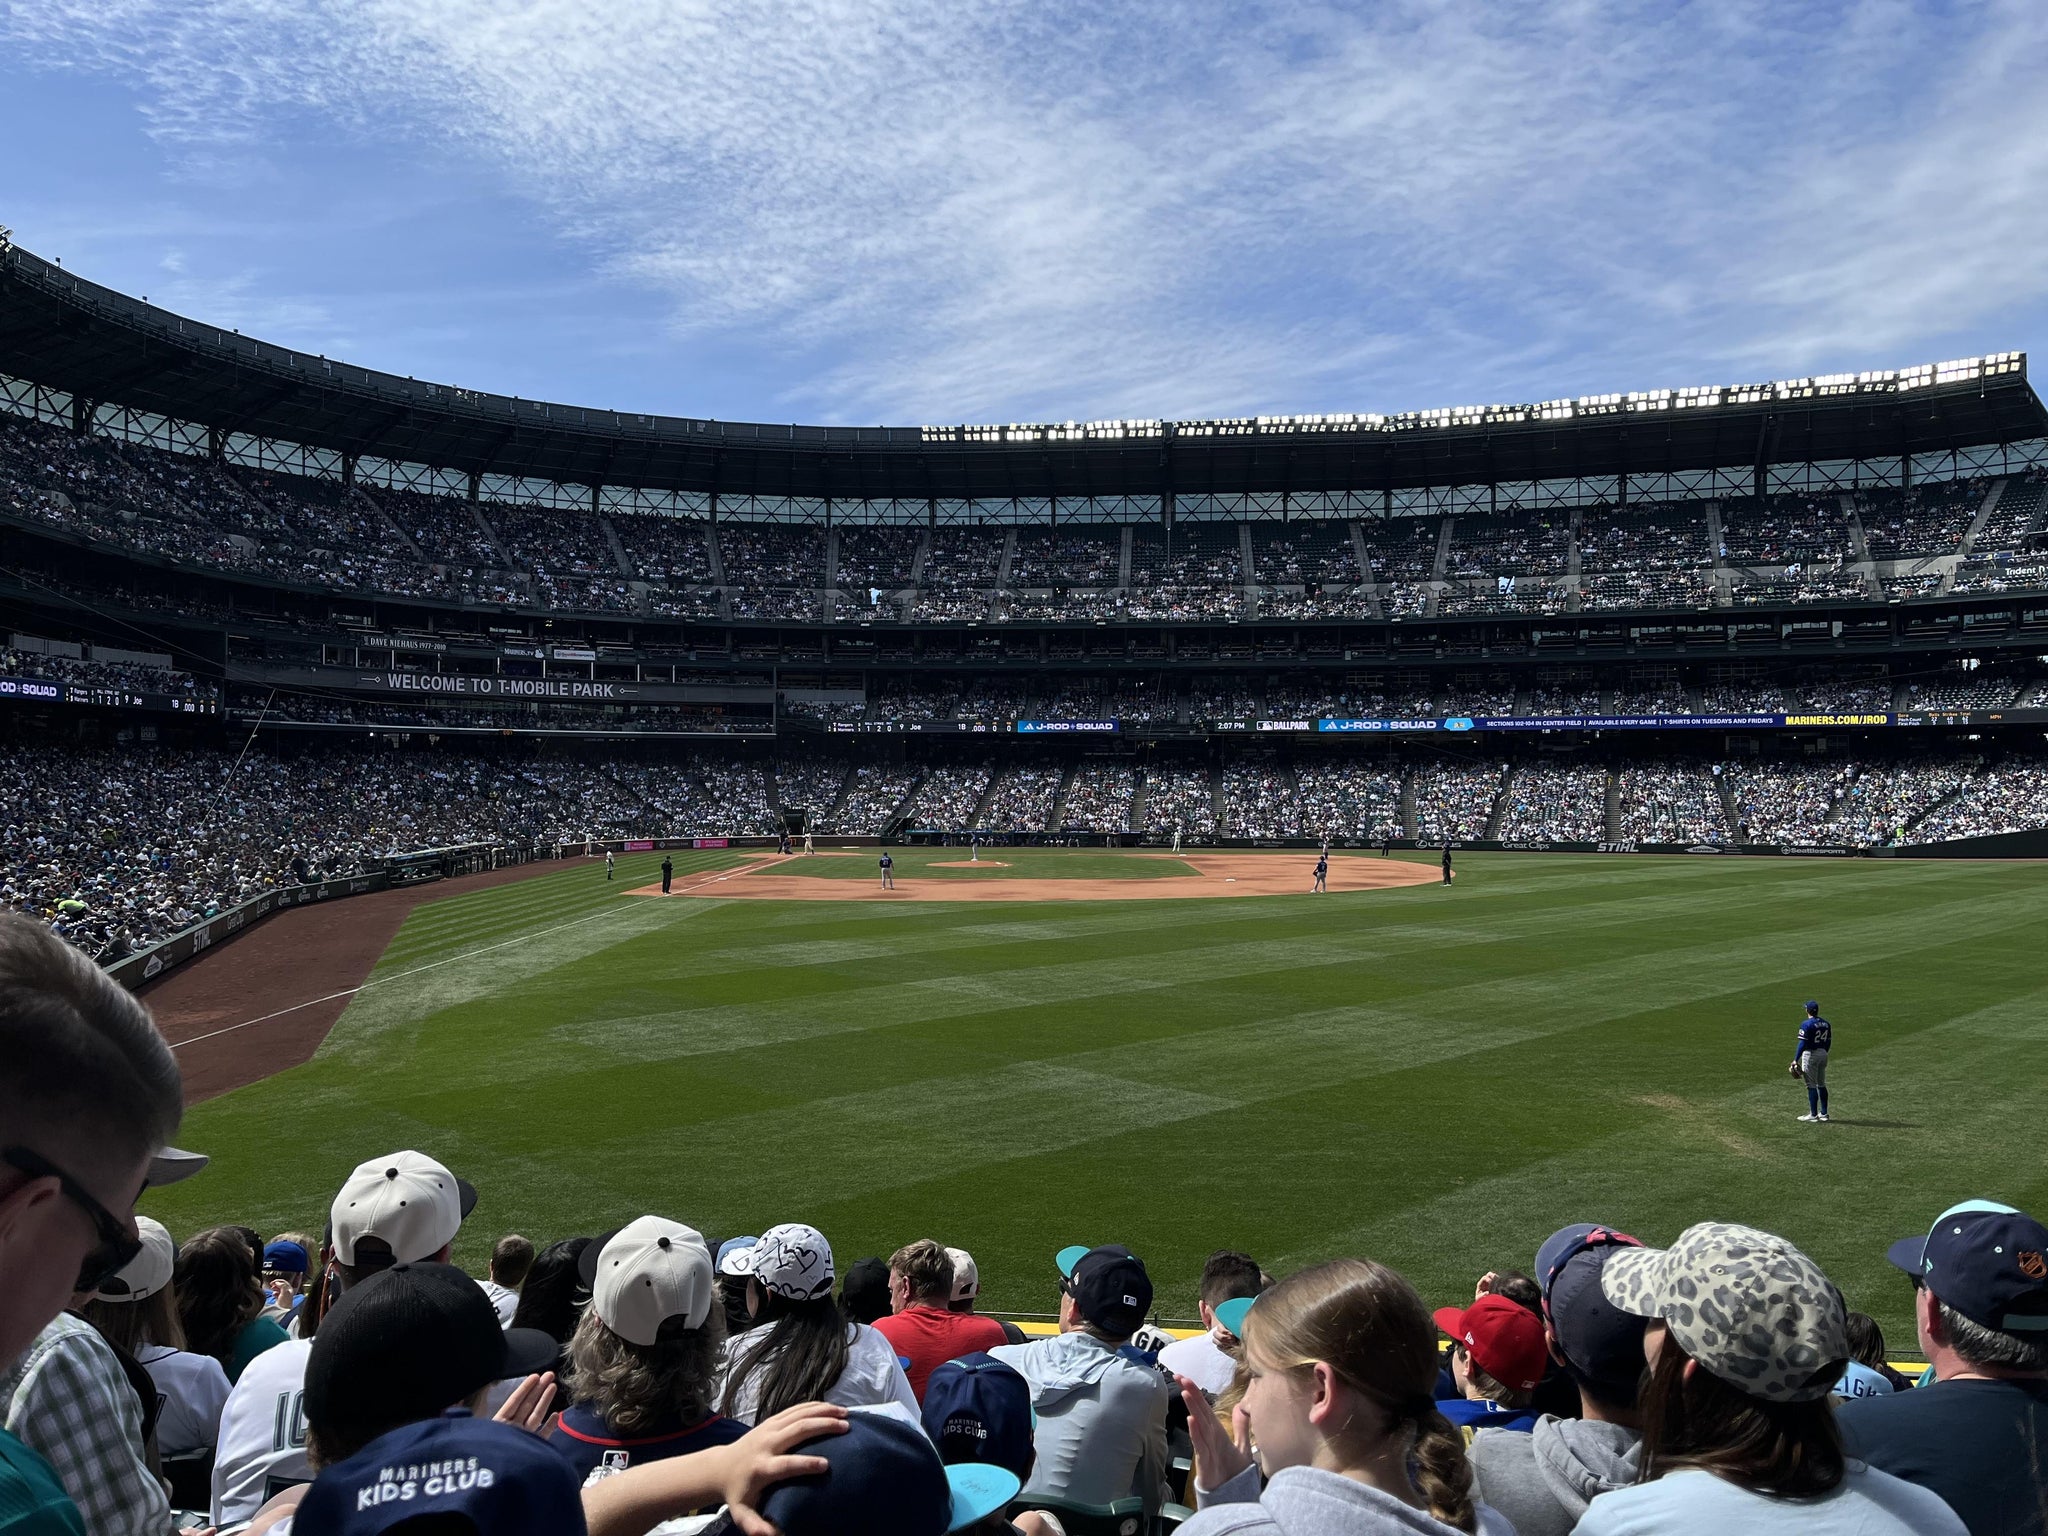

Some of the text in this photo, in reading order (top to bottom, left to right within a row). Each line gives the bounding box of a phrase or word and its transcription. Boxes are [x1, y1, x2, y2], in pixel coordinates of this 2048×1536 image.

[2005, 567, 2036, 575] Trident
[370, 638, 388, 646] DAVE
[390, 639, 418, 648] NIEHAUS
[22, 683, 57, 697] SQUAD
[387, 673, 614, 698] WELCOME TO T-MOBILE PARK
[98, 694, 102, 704] 1
[106, 696, 111, 705] 2
[124, 694, 143, 706] 9 Joe
[183, 703, 216, 714] .000 0 0
[1217, 721, 1310, 730] 2:07 PM BALLPARK
[1340, 721, 1437, 730] J-ROD SQUAD
[1785, 714, 1888, 726] MARINERS.COM/JROD
[1502, 841, 1550, 850] Great Clips
[1596, 842, 1640, 852] STIHL
[1814, 1030, 1828, 1044] 24
[948, 1418, 982, 1428] MARINERS
[964, 1426, 987, 1439] CLUB
[380, 1456, 478, 1483] MARINERS
[357, 1468, 494, 1512] KIDS CLUB
